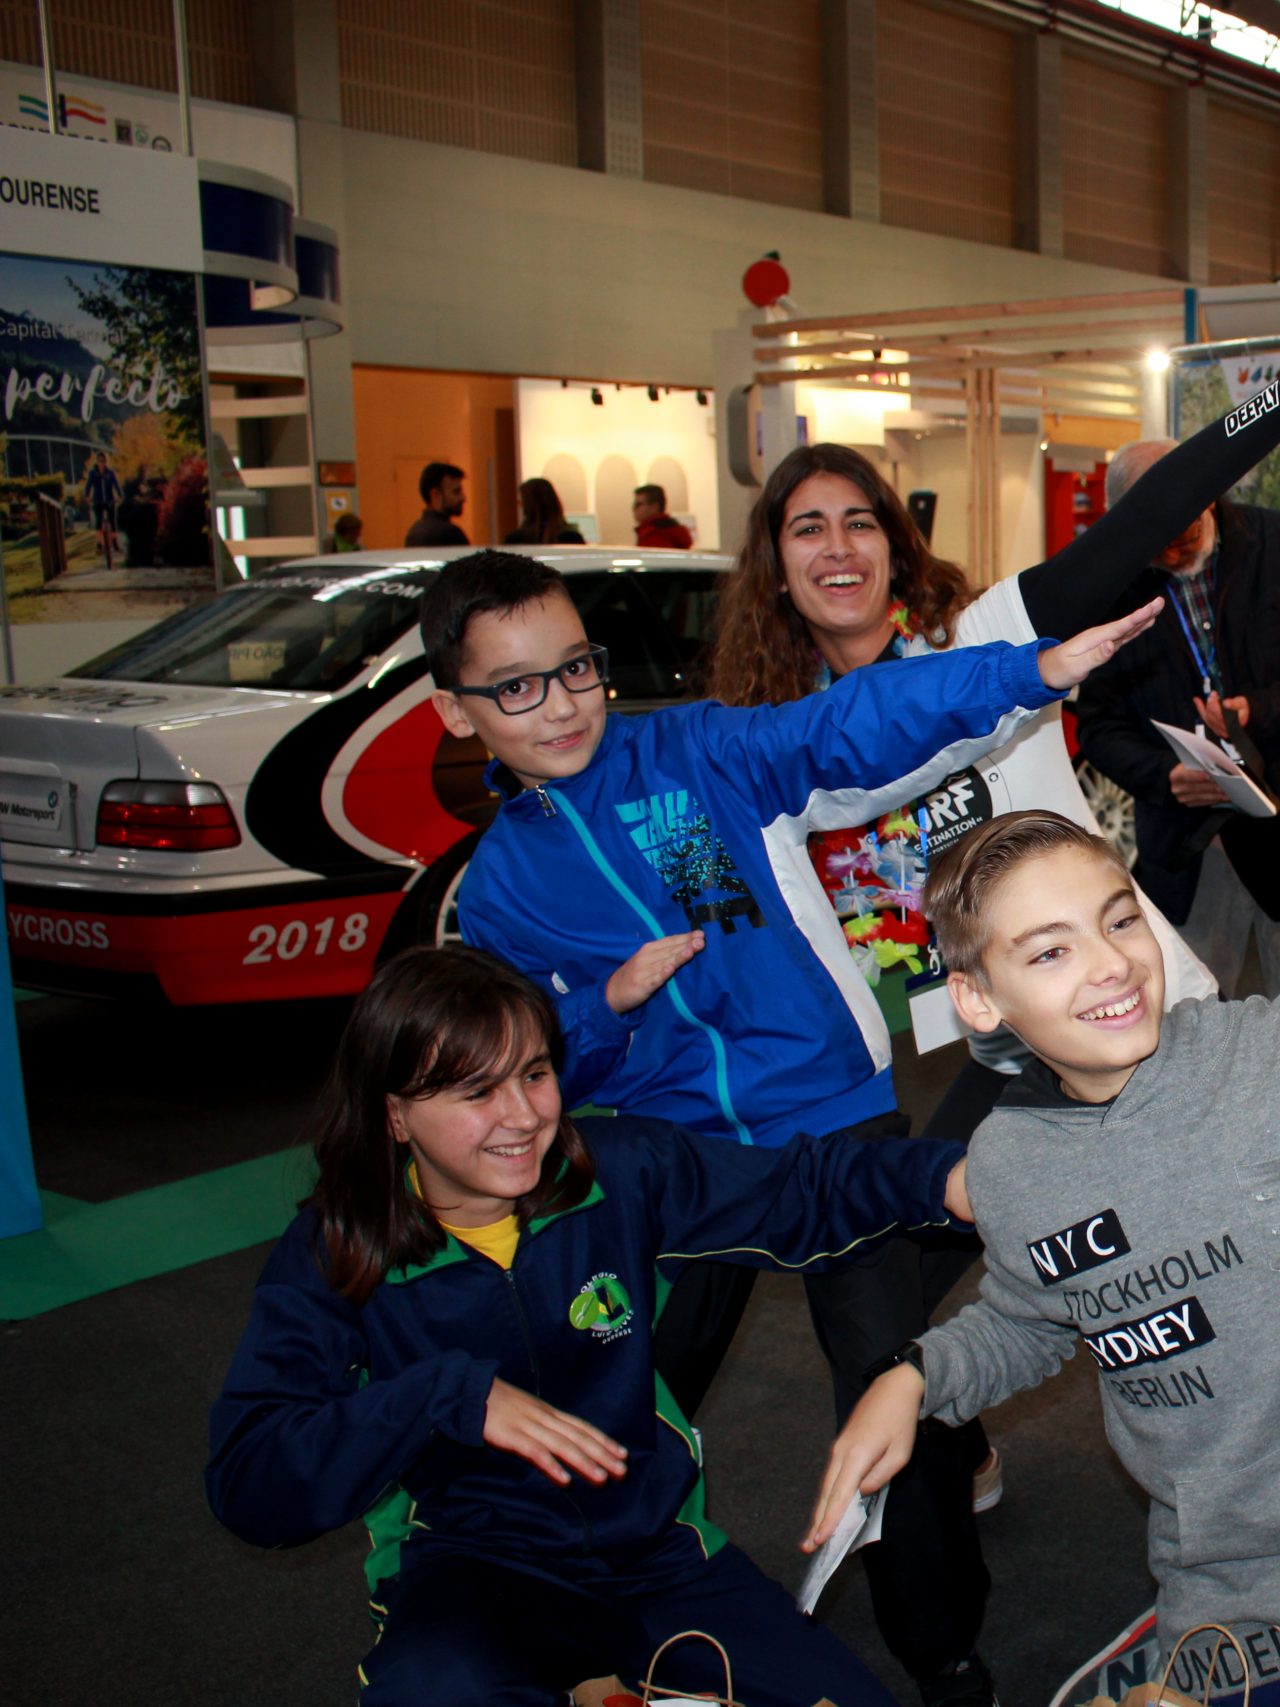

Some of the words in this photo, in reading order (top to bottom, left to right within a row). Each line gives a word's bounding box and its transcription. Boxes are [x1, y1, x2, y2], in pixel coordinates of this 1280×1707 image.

[0, 176, 100, 214] OURENSE
[5, 360, 190, 423] perfecto
[1225, 379, 1280, 437] DEEPLY
[11, 803, 56, 821] Motorsport
[7, 912, 109, 949] YCROSS
[242, 912, 369, 965] 2018
[1063, 1234, 1244, 1321] STOCKHOLM
[1111, 1366, 1215, 1408] BERLIN
